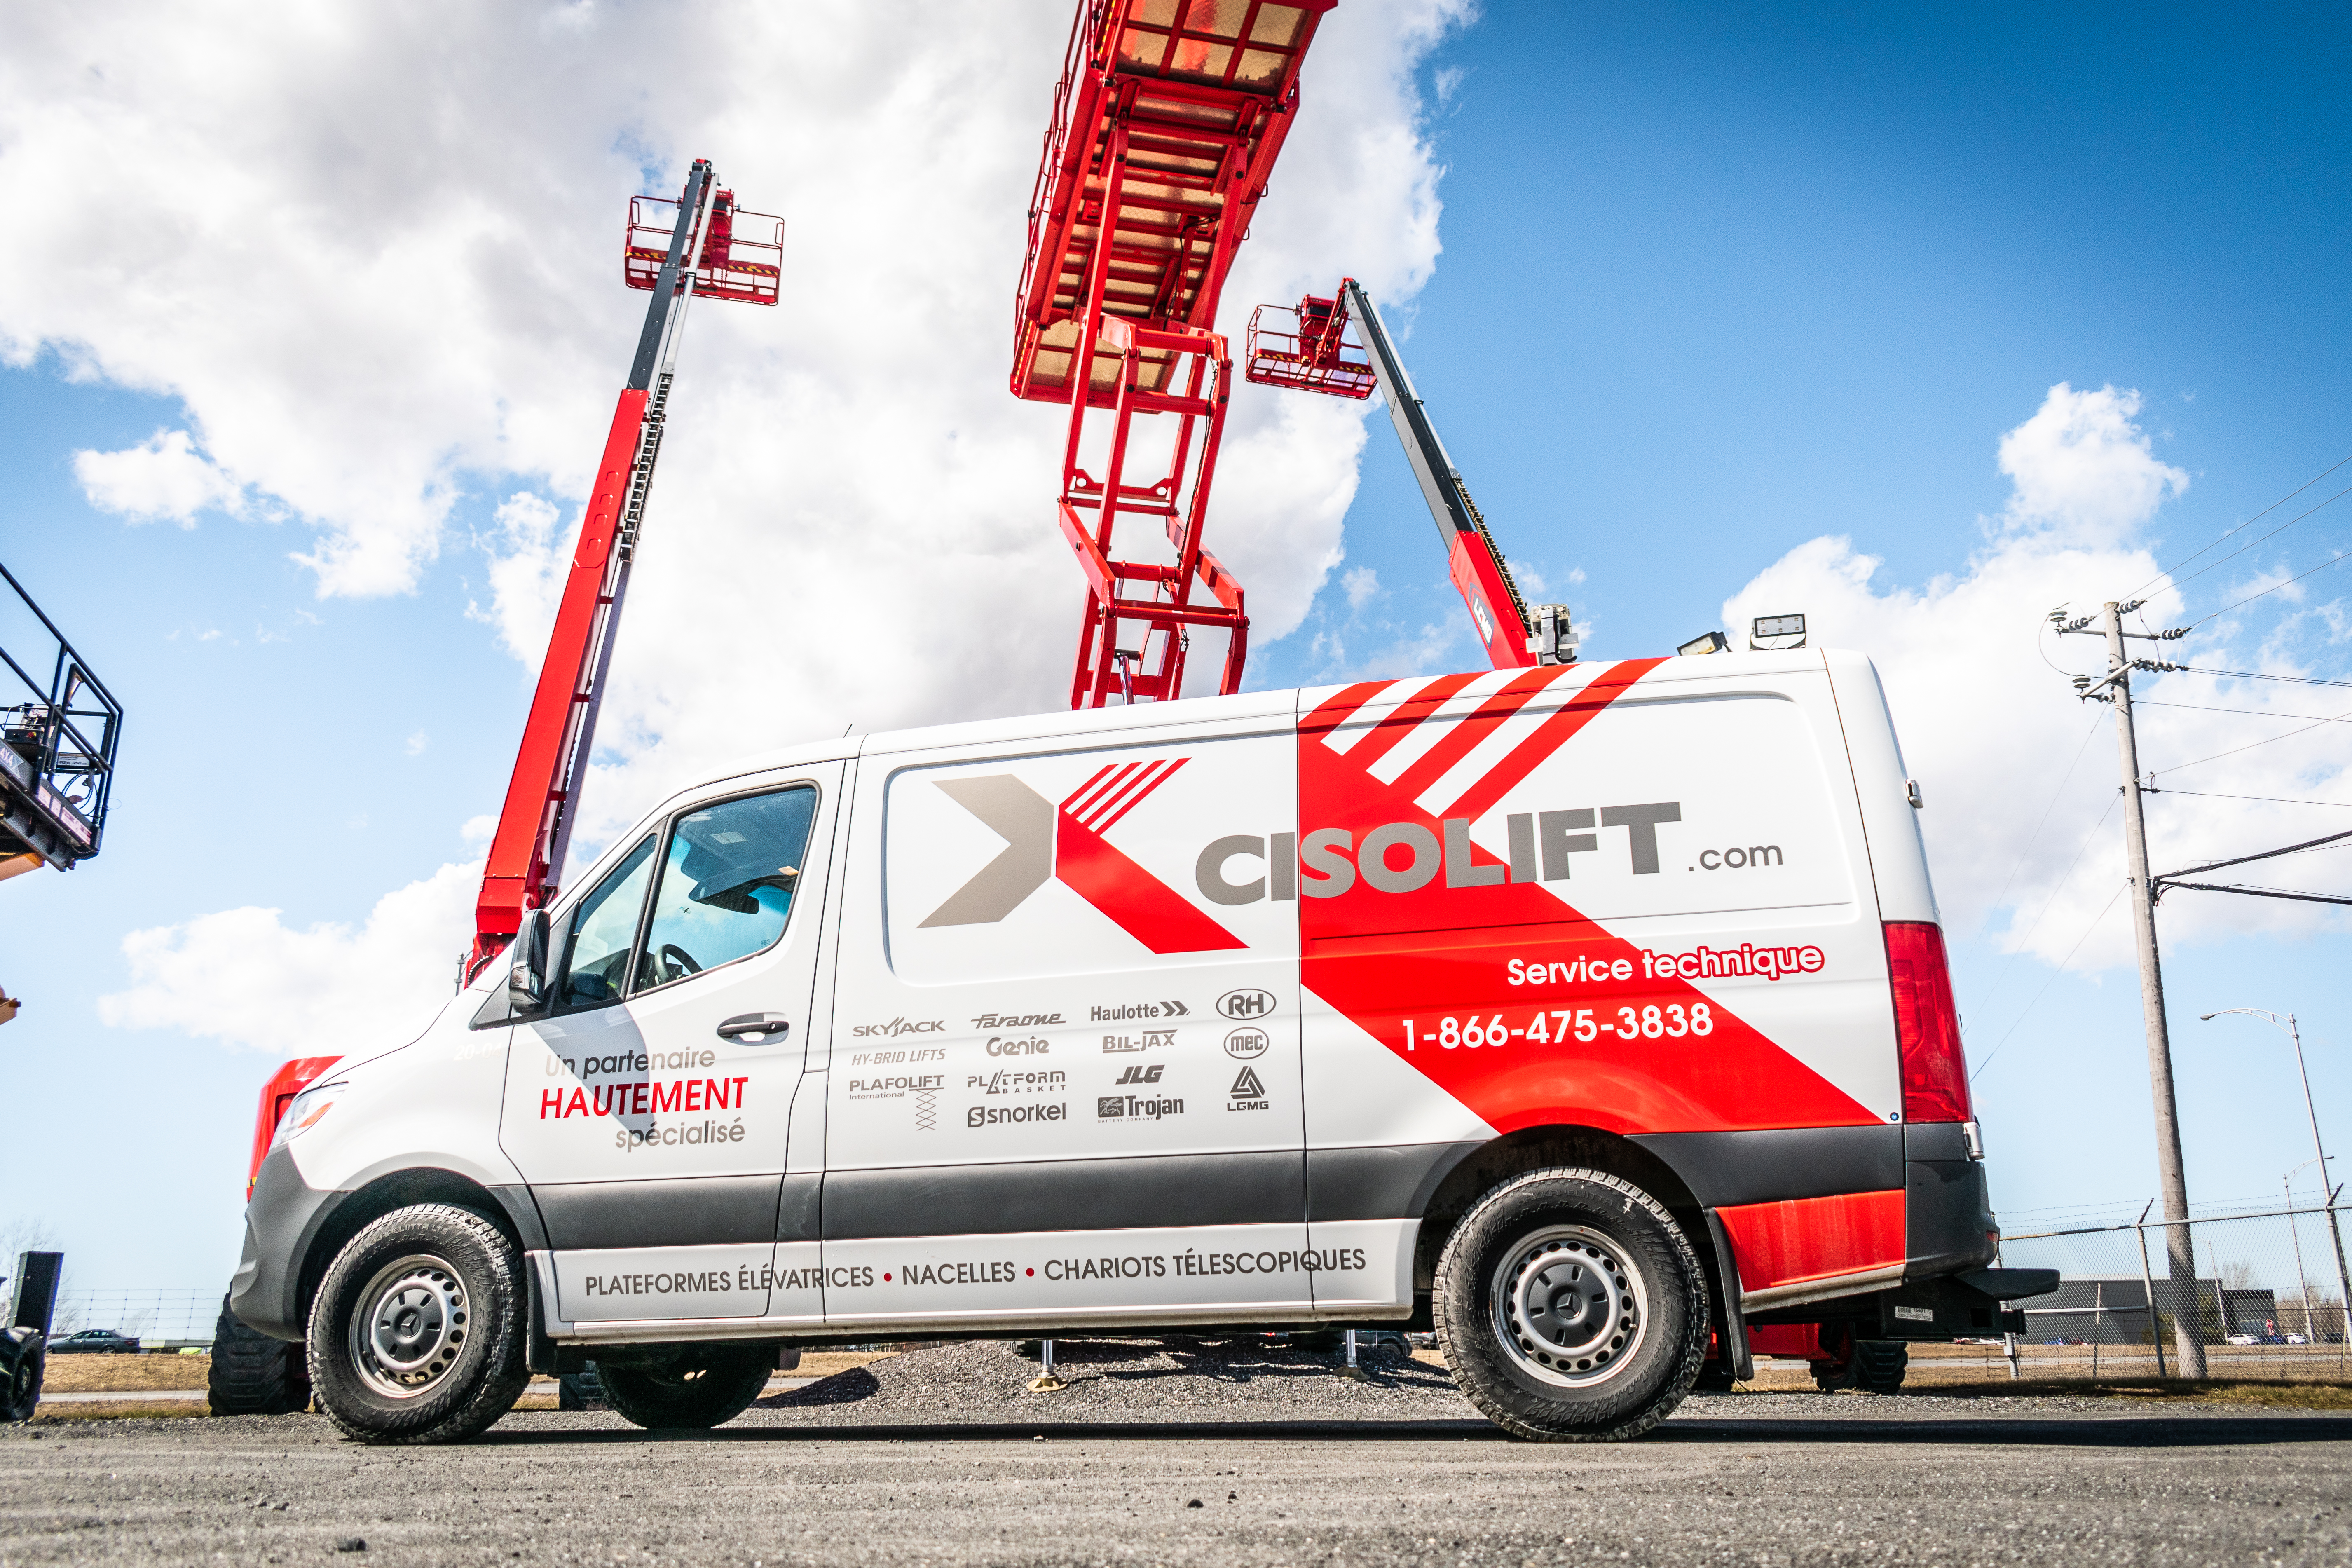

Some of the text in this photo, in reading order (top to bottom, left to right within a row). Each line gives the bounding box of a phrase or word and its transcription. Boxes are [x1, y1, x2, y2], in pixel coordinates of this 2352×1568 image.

[1195, 801, 1783, 906] CISOLIFT .com
[1507, 944, 1824, 985] Service technique
[971, 1013, 1066, 1029] Faraone
[1091, 1004, 1159, 1021] Haulotte
[853, 1016, 946, 1037] SKYJACK
[1403, 1003, 1713, 1052] 1-866-475-3838
[986, 1036, 1049, 1057] Genie
[1103, 1030, 1178, 1053] BIL-JAX
[546, 1046, 715, 1079] Un partenaire
[852, 1049, 946, 1066] HY-BRID LIFTS
[850, 1075, 944, 1092] PLAFOLIFT
[1115, 1064, 1165, 1085] JLG
[540, 1077, 748, 1119] HAUTEMENT
[850, 1091, 904, 1100] International
[1003, 1085, 1066, 1094] BASKET
[987, 1102, 1066, 1124] snorkel
[1125, 1094, 1184, 1120] Trojan
[1227, 1101, 1269, 1111] LGMG
[616, 1116, 745, 1152] spécialisé
[585, 1248, 1366, 1296] PLATEFORMES ÉLÉVATRICES NACELLES CHARIOTS TÉLESCOPIQUES
